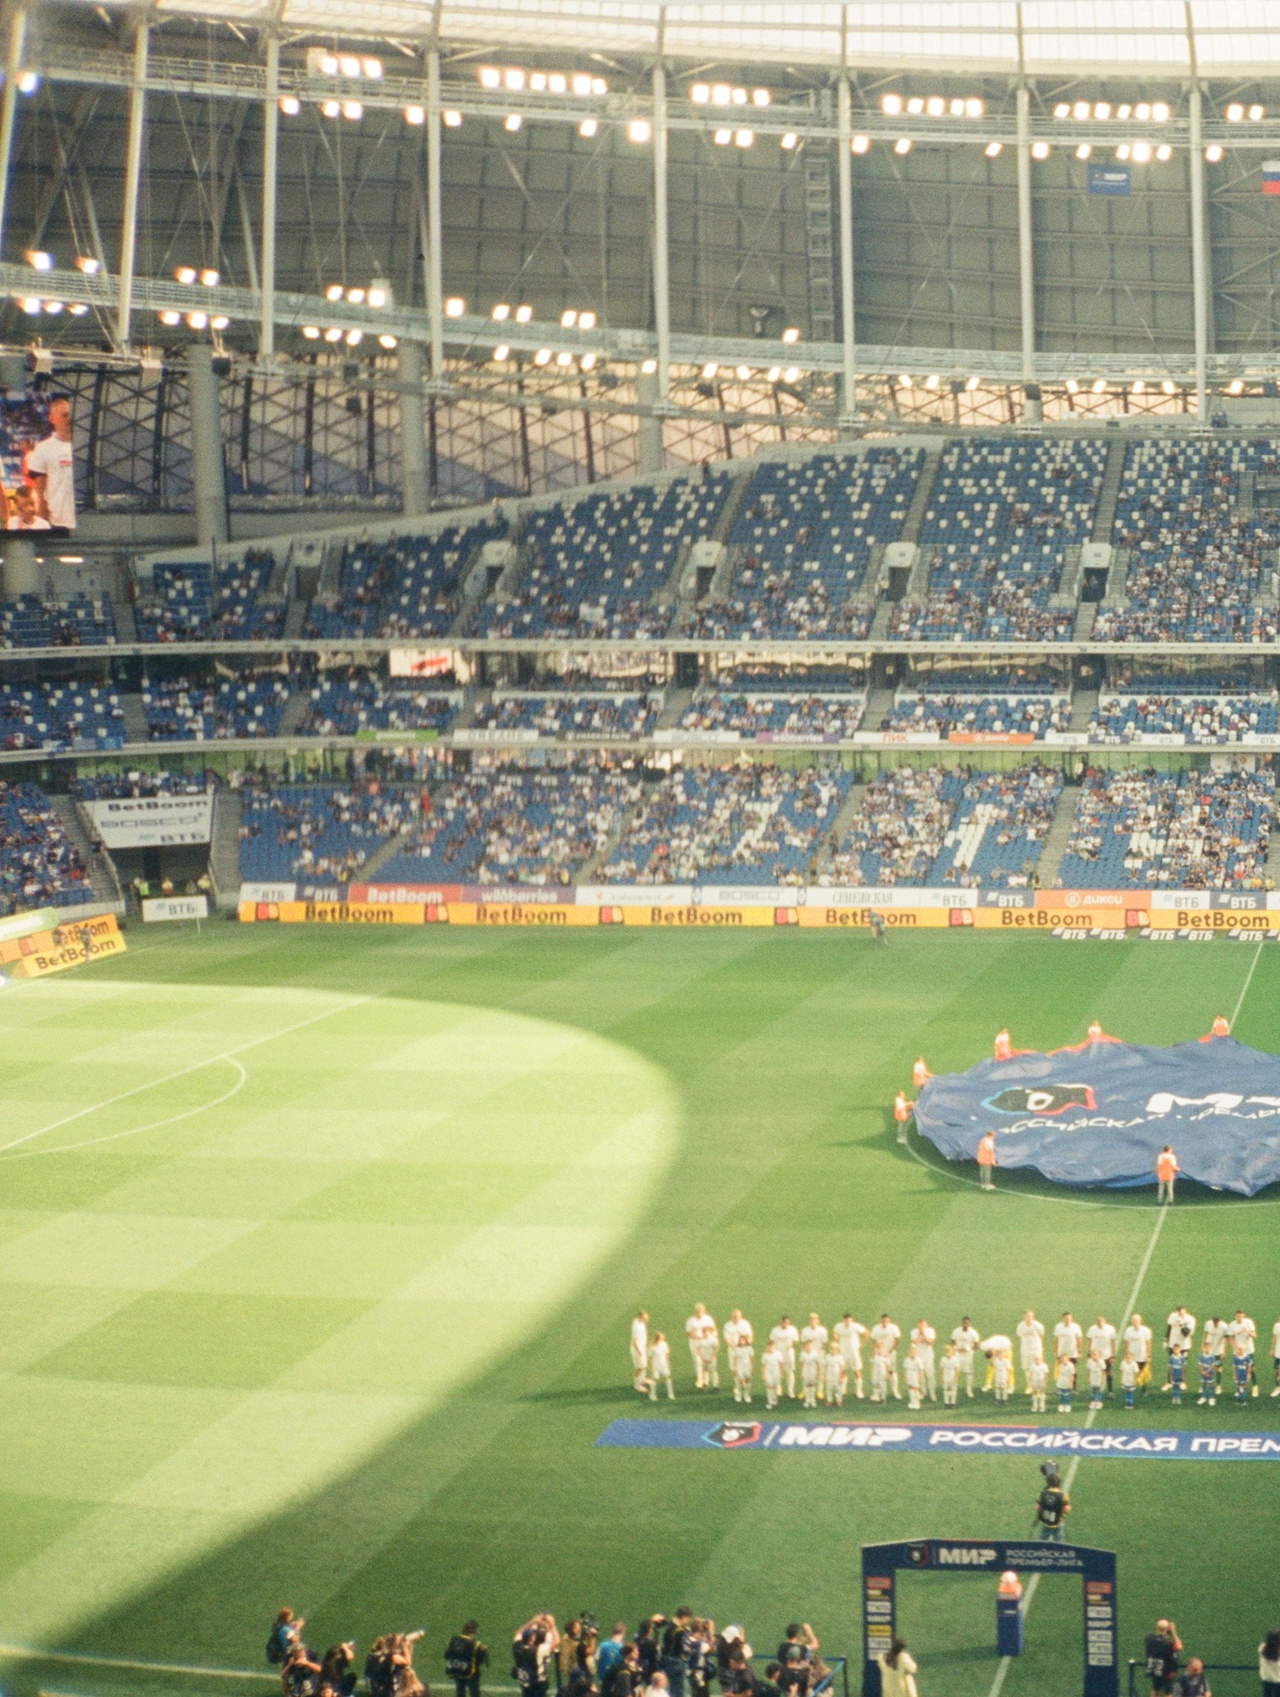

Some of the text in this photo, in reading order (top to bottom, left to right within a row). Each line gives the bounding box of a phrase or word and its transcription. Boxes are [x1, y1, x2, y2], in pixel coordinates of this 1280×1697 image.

[108, 800, 208, 812] BetBoom
[367, 887, 442, 903] BetBoom
[942, 895, 967, 906] ВТБ
[998, 895, 1024, 907] ВТБ
[1174, 897, 1199, 908] ВТБ
[1231, 896, 1256, 909] ВТБ
[305, 905, 394, 921] BetBoom
[476, 907, 567, 923] BetBoom
[650, 908, 743, 924] BetBoom
[1001, 910, 1093, 926] BetBoom
[1177, 912, 1270, 928] BetBoom
[1062, 929, 1087, 940] ВТБ
[1101, 929, 1125, 940] ВТБ
[1151, 929, 1175, 940] ВТБ
[1188, 930, 1213, 940] ВТБ
[1239, 930, 1264, 941] ВТБ
[778, 1426, 912, 1446] МИР
[929, 1429, 1177, 1452] РОССИЙСКАЯ
[939, 1548, 997, 1565] МИР
